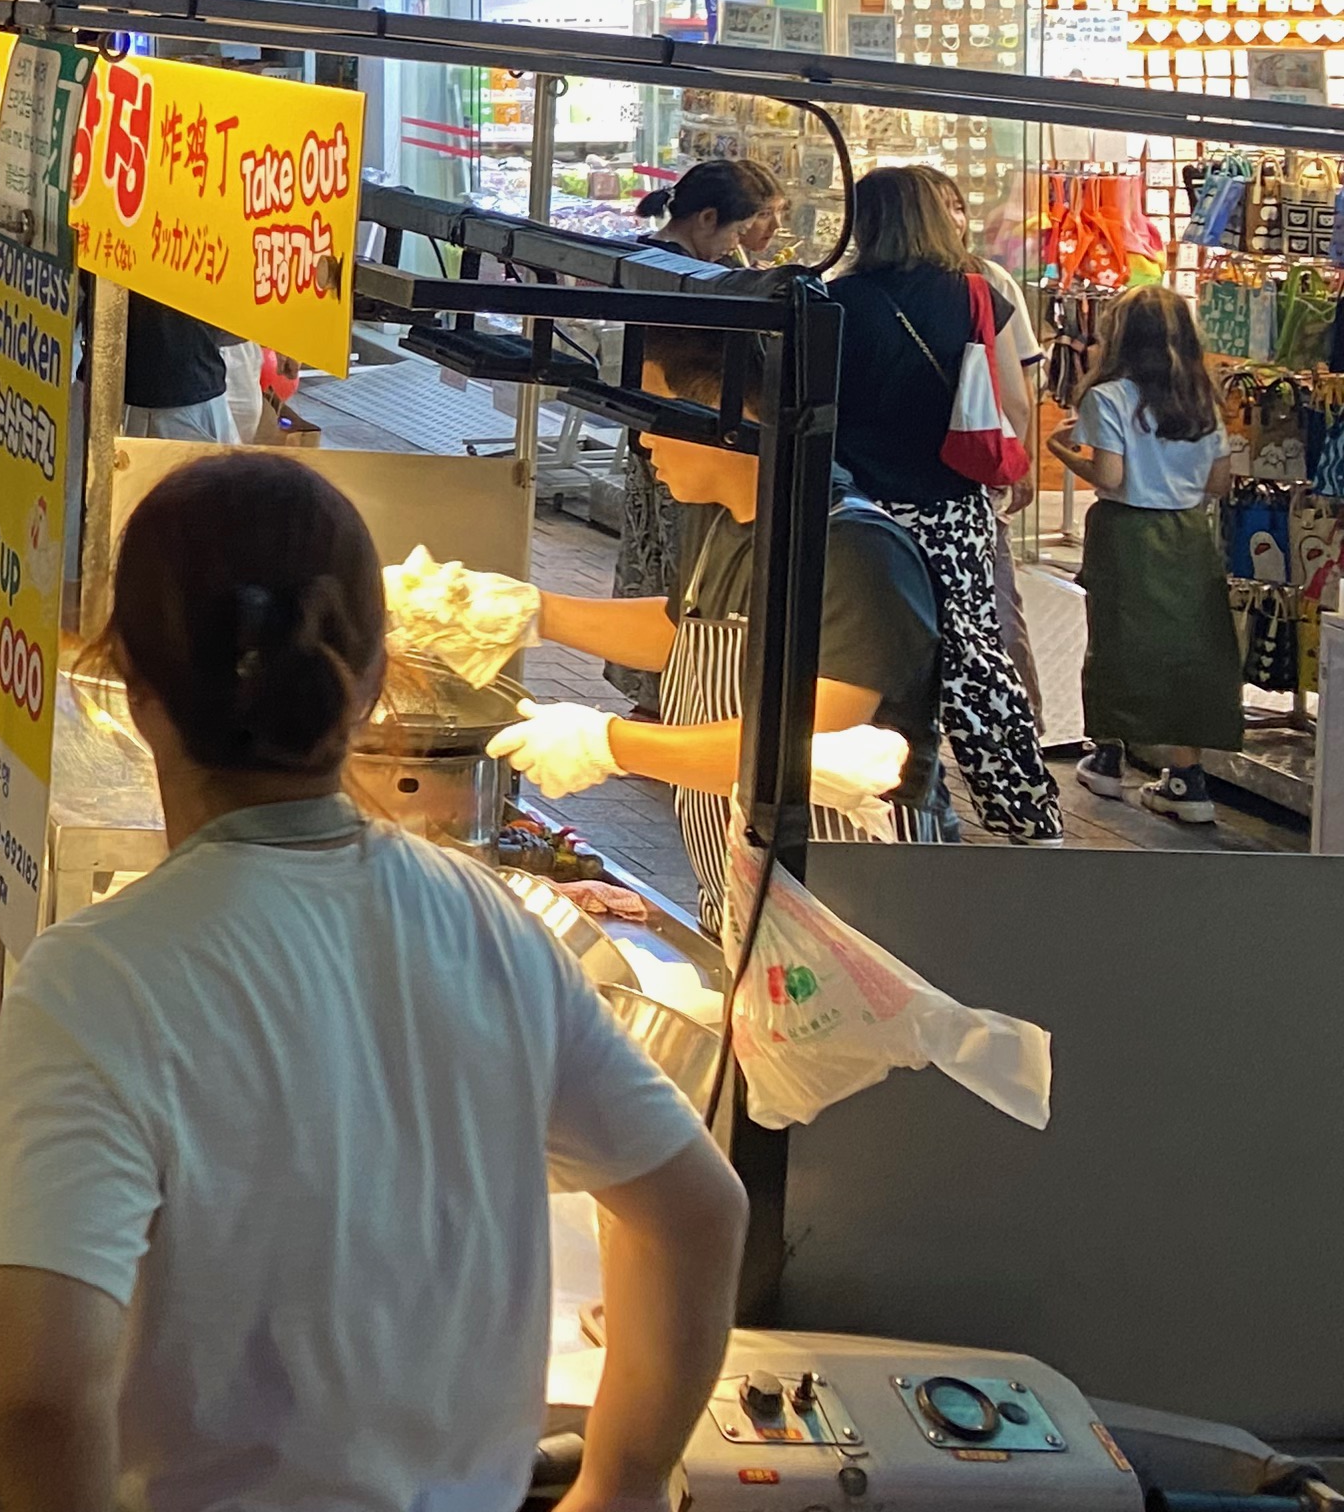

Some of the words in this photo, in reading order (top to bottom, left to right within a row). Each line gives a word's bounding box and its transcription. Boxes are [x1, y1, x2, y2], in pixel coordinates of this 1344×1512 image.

[159, 99, 239, 199] 炸鸡丁
[240, 143, 295, 220] Take
[299, 121, 350, 207] Out
[151, 210, 230, 285] タッカンジョン
